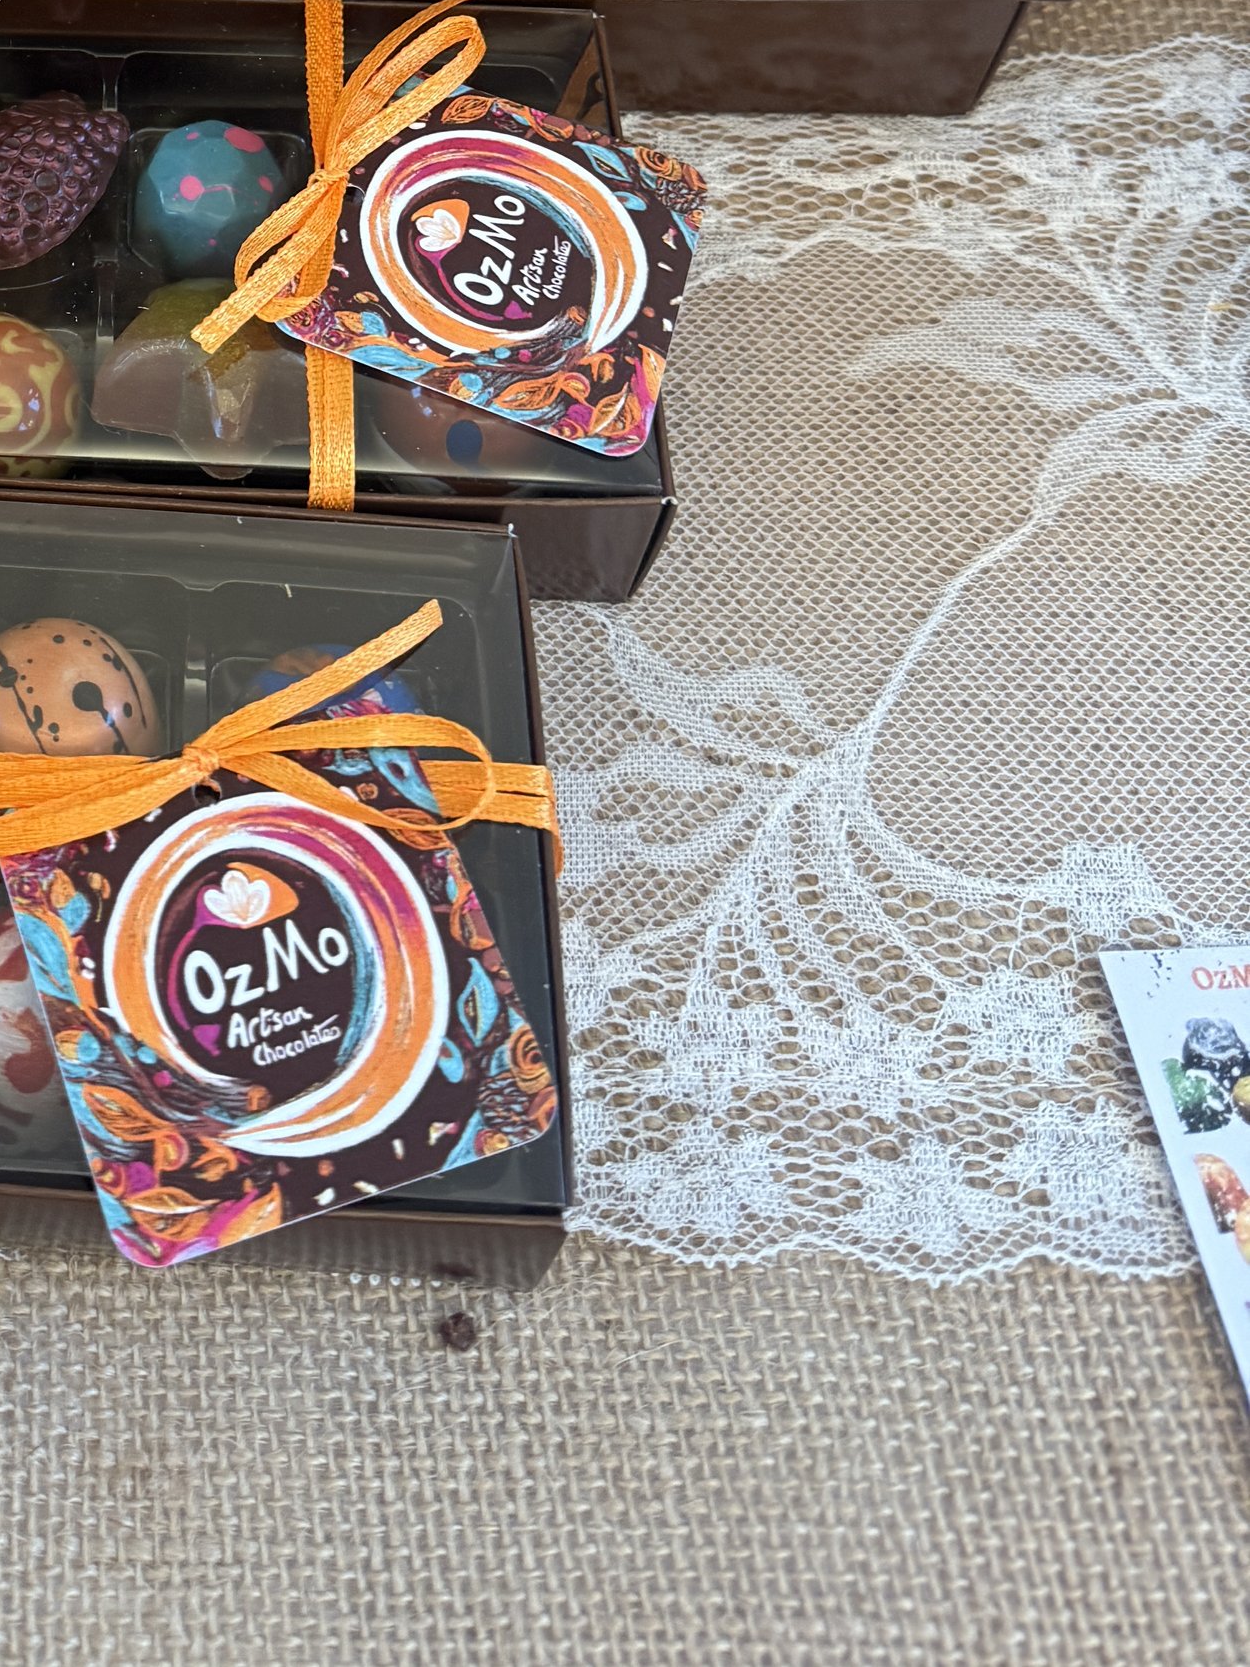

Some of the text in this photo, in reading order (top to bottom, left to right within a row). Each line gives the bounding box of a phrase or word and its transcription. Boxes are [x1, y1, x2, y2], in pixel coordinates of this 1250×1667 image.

[453, 195, 526, 306] OzMo
[183, 918, 349, 1014] OzMo
[1191, 964, 1250, 990] OzM
[227, 1006, 313, 1049] Artisan
